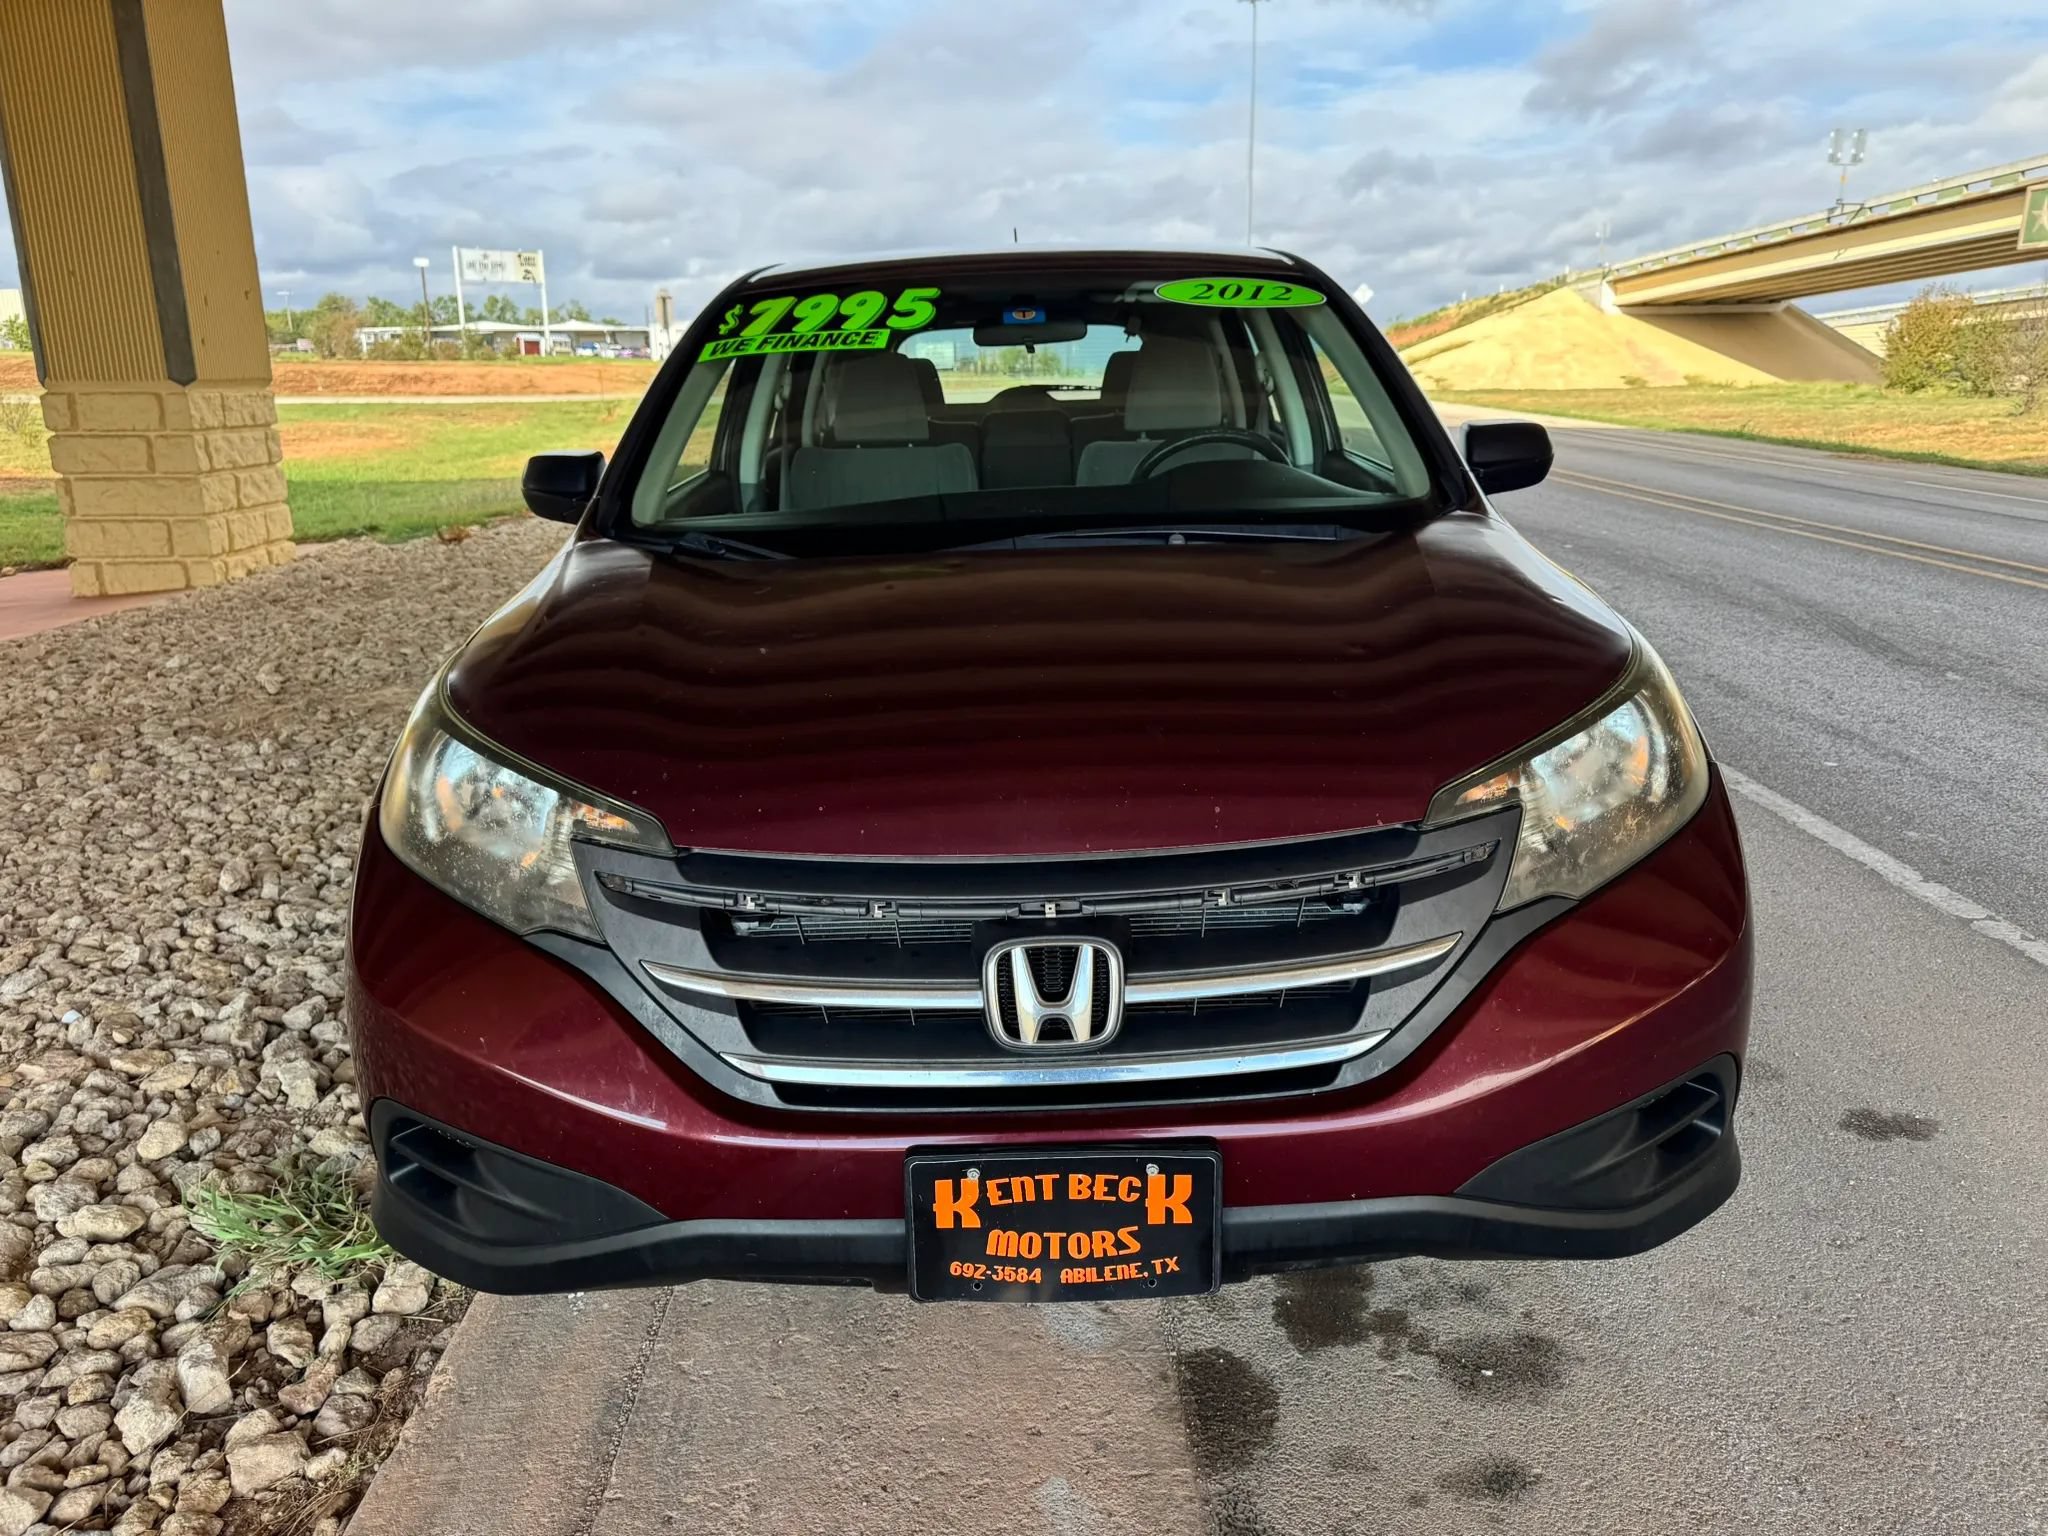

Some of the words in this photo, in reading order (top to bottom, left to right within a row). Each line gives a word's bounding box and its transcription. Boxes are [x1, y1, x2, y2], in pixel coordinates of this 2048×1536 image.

[1189, 282, 1293, 301] 2012
[718, 287, 942, 337] $7995
[709, 336, 756, 357] WE
[755, 330, 882, 352] FINANCE
[933, 1173, 1060, 1229] KENT
[1068, 1173, 1193, 1225] BECK
[986, 1225, 1142, 1260] MOTORS
[949, 1260, 1042, 1284] 692-3584
[1151, 1256, 1180, 1276] TX
